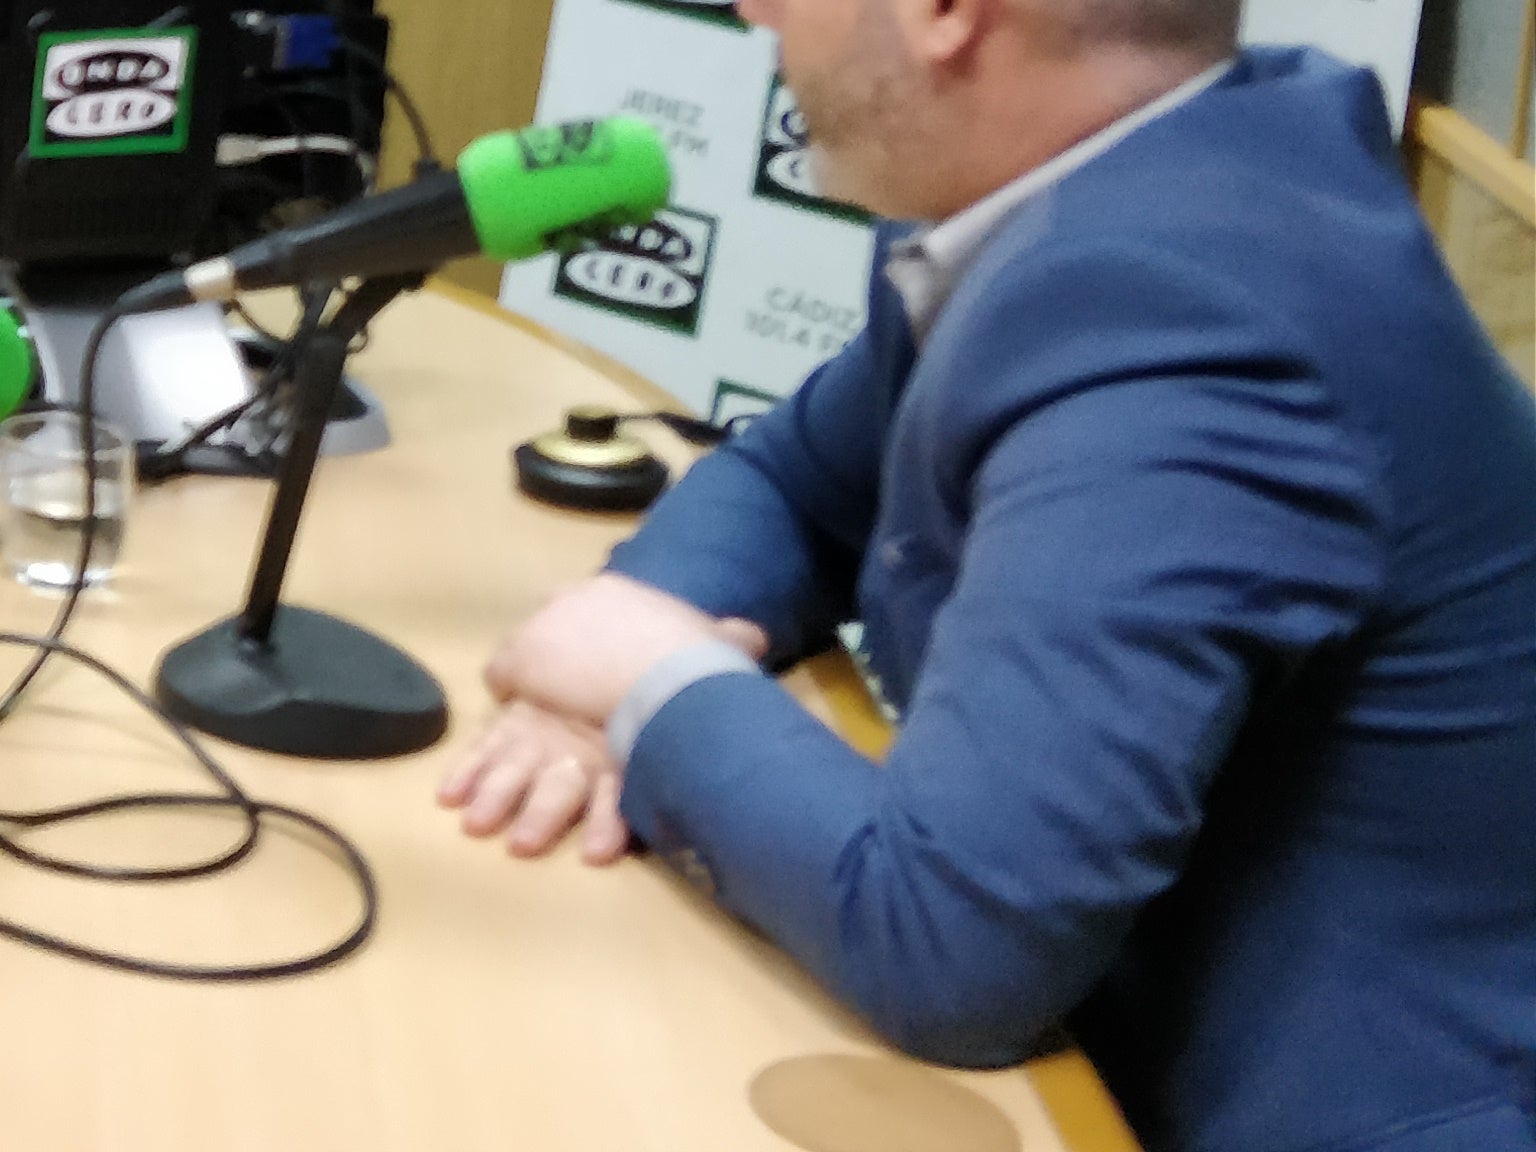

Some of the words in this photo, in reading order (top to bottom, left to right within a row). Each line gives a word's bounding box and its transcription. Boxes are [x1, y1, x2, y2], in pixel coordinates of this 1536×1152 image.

[62, 58, 164, 87] ONDA
[67, 101, 155, 125] CERO
[585, 257, 676, 299] CERO
